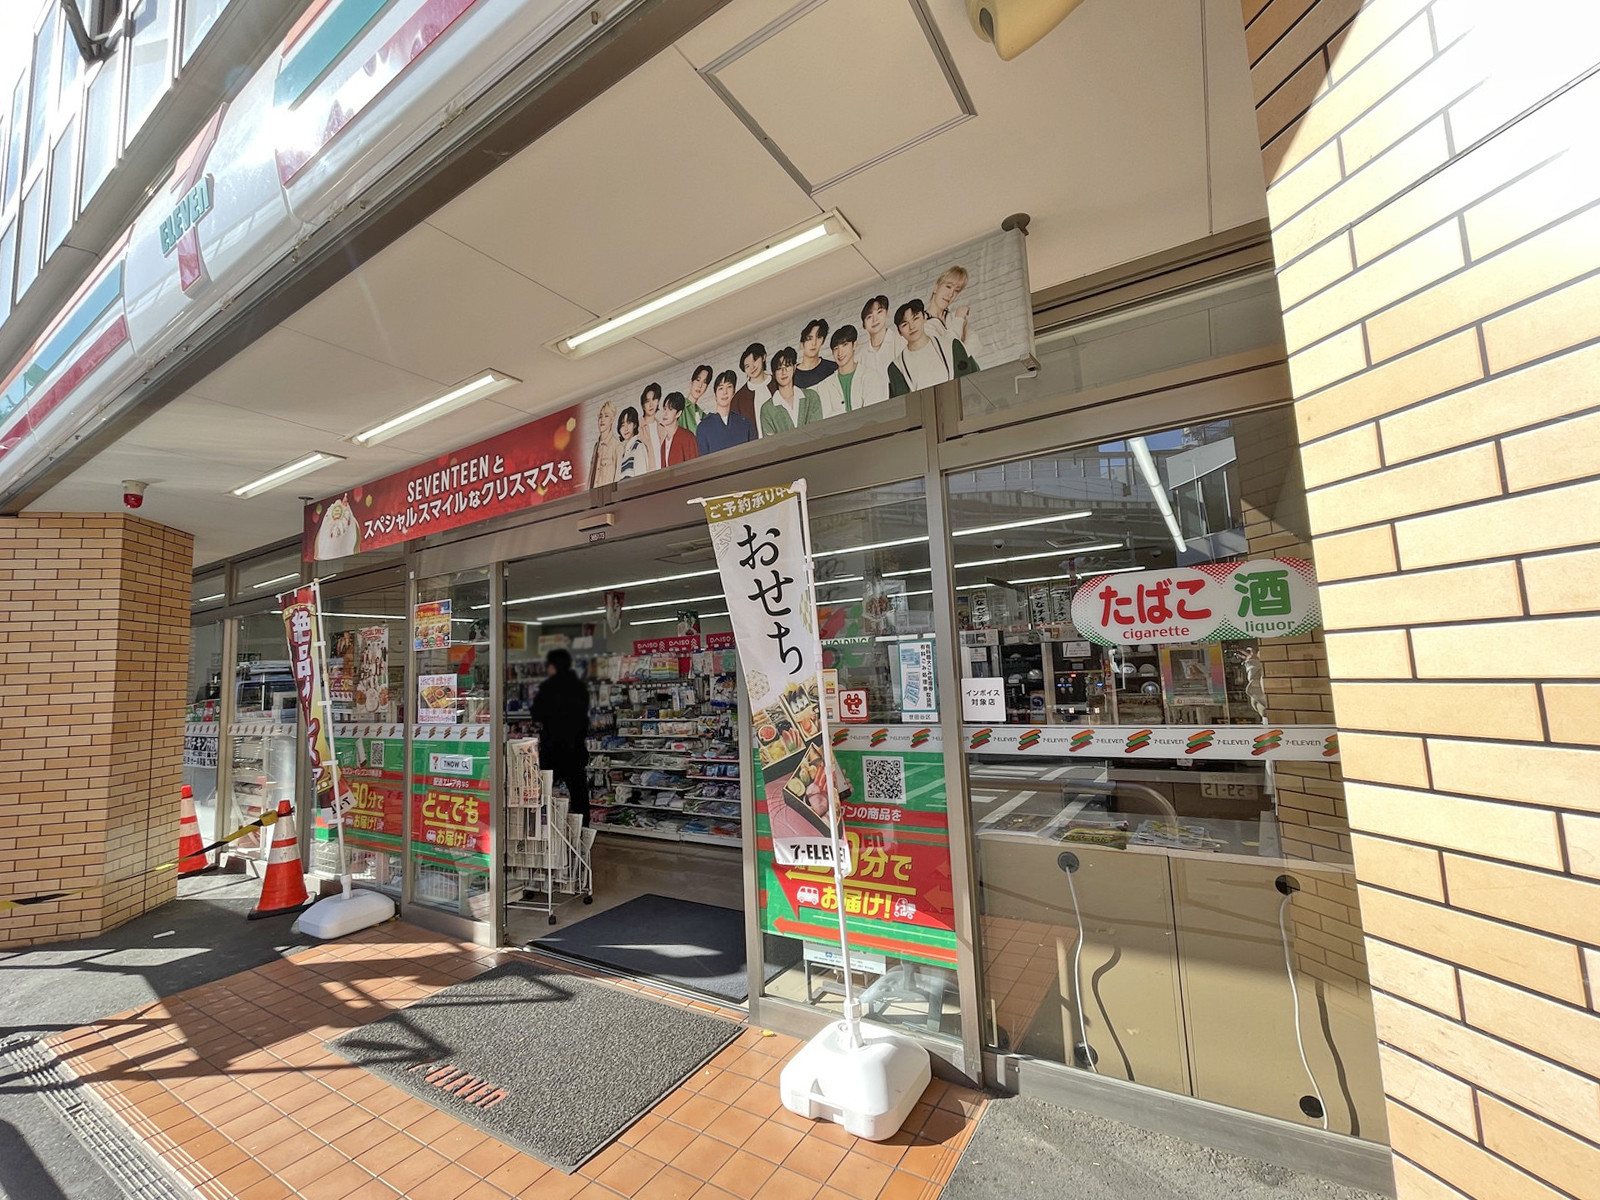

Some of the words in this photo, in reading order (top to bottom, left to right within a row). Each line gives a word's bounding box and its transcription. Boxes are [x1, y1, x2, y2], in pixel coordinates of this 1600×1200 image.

[407, 455, 489, 503] SEVENTEEN
[493, 455, 504, 474] と
[364, 460, 573, 541] スペシャルスマイルなクリスマスを
[737, 524, 803, 675] おせち
[1099, 578, 1212, 626] たばこ
[1234, 570, 1292, 617] 酒
[1123, 626, 1190, 641] cigarette
[1245, 619, 1296, 634] liquor
[668, 639, 690, 647] DAISO
[709, 635, 731, 643] DAISO
[966, 689, 1001, 698] インボイス
[971, 698, 996, 707] 対象店
[443, 760, 460, 768] 7NOW
[422, 792, 479, 825] どこでも
[436, 829, 467, 849] お届け!
[821, 885, 892, 919] お届け!
